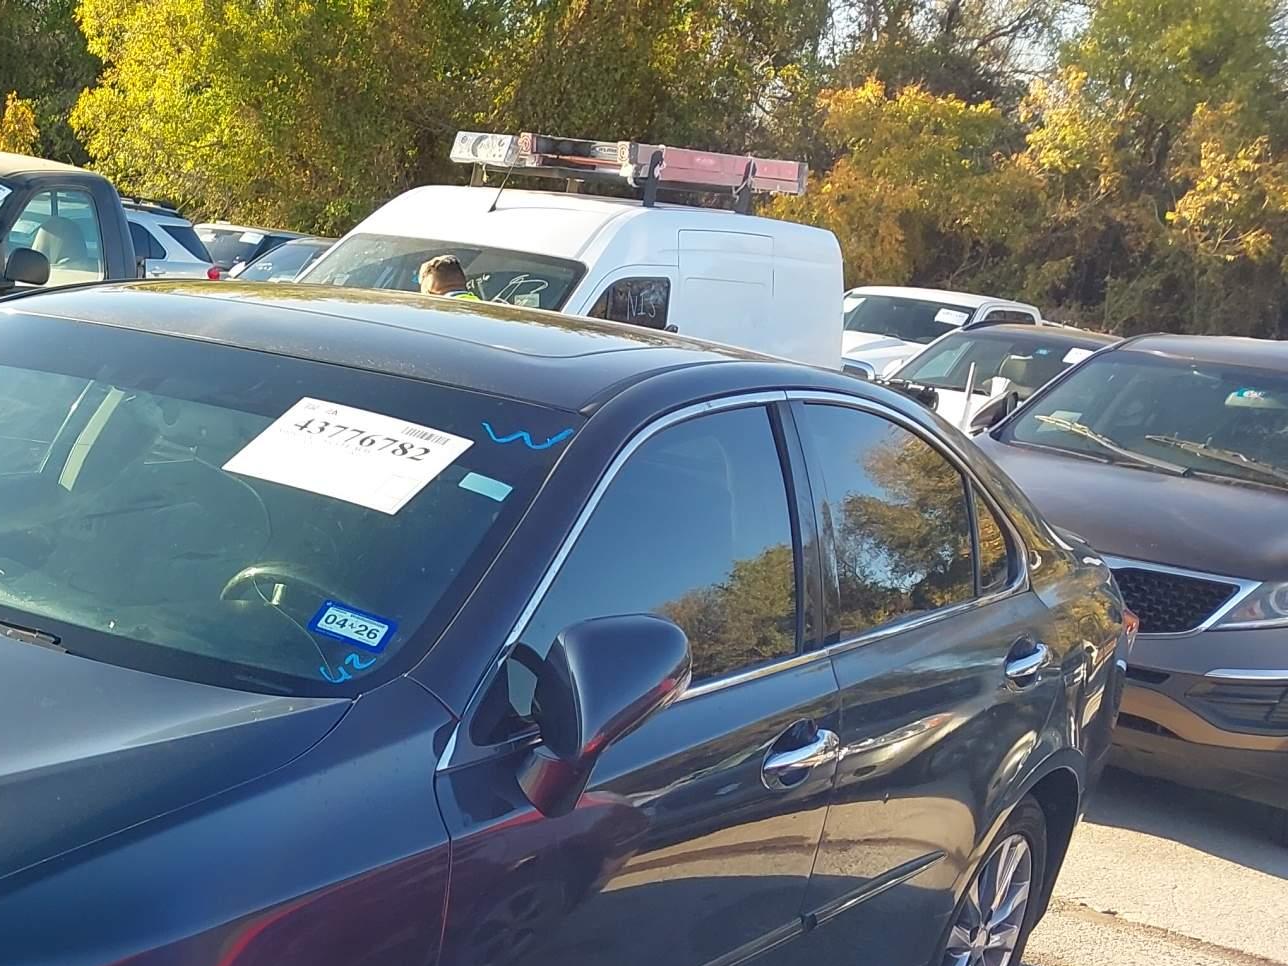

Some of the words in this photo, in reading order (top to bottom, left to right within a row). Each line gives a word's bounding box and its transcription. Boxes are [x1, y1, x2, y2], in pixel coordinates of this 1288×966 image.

[293, 418, 431, 461] 43776782
[324, 614, 348, 629] 04
[354, 624, 380, 640] 26
